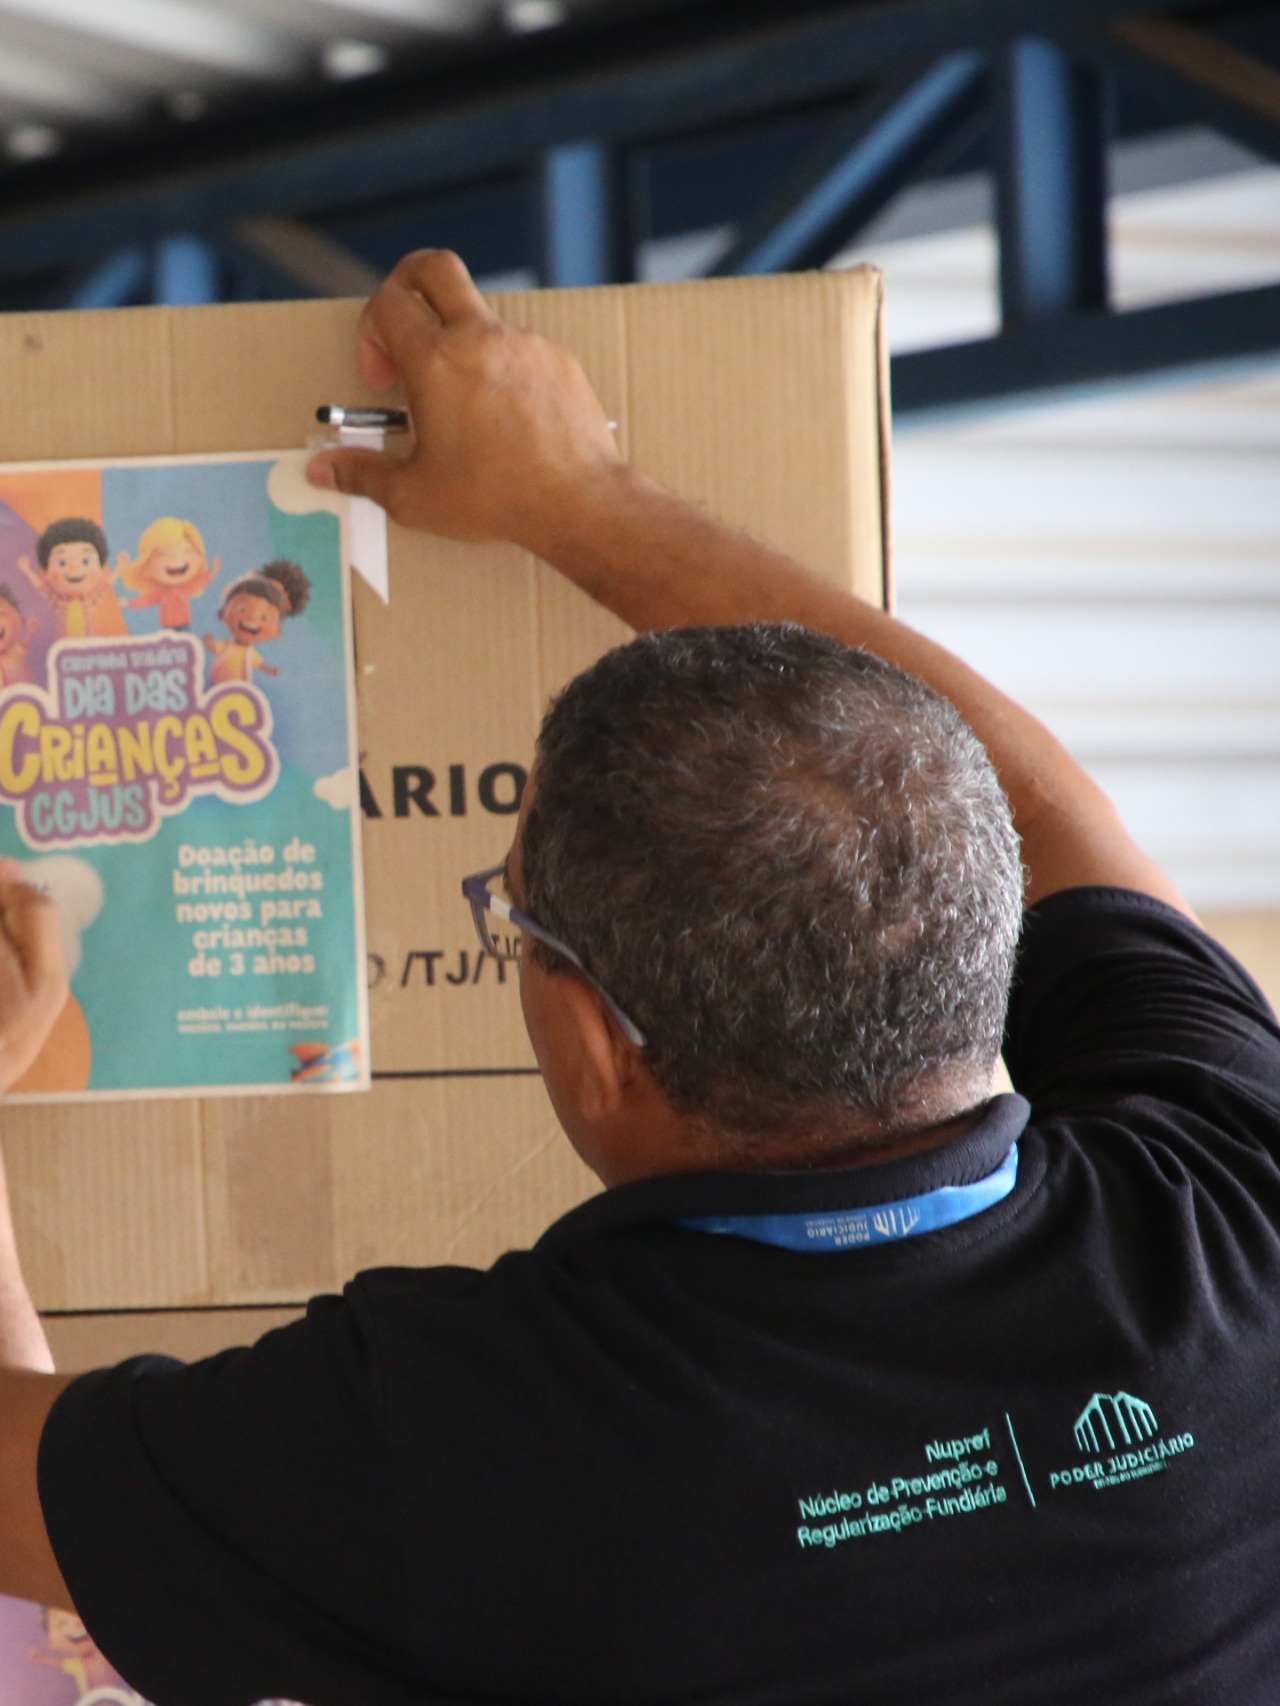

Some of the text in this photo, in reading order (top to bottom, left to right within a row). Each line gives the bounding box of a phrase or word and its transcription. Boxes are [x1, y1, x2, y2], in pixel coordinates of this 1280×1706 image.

[178, 836, 317, 873] Doação de
[173, 864, 324, 900] brinquedos
[176, 898, 324, 926] novos para
[193, 922, 309, 956] crianças
[188, 950, 316, 977] de 3 anos
[1049, 1461, 1105, 1490] PODER
[1107, 1432, 1195, 1474] JUDICIÁRIO
[798, 1488, 863, 1520] Núcleo
[866, 1481, 890, 1505] de
[891, 1460, 983, 1500] Prevenção
[797, 1482, 1008, 1549] Regularização Fundiária
